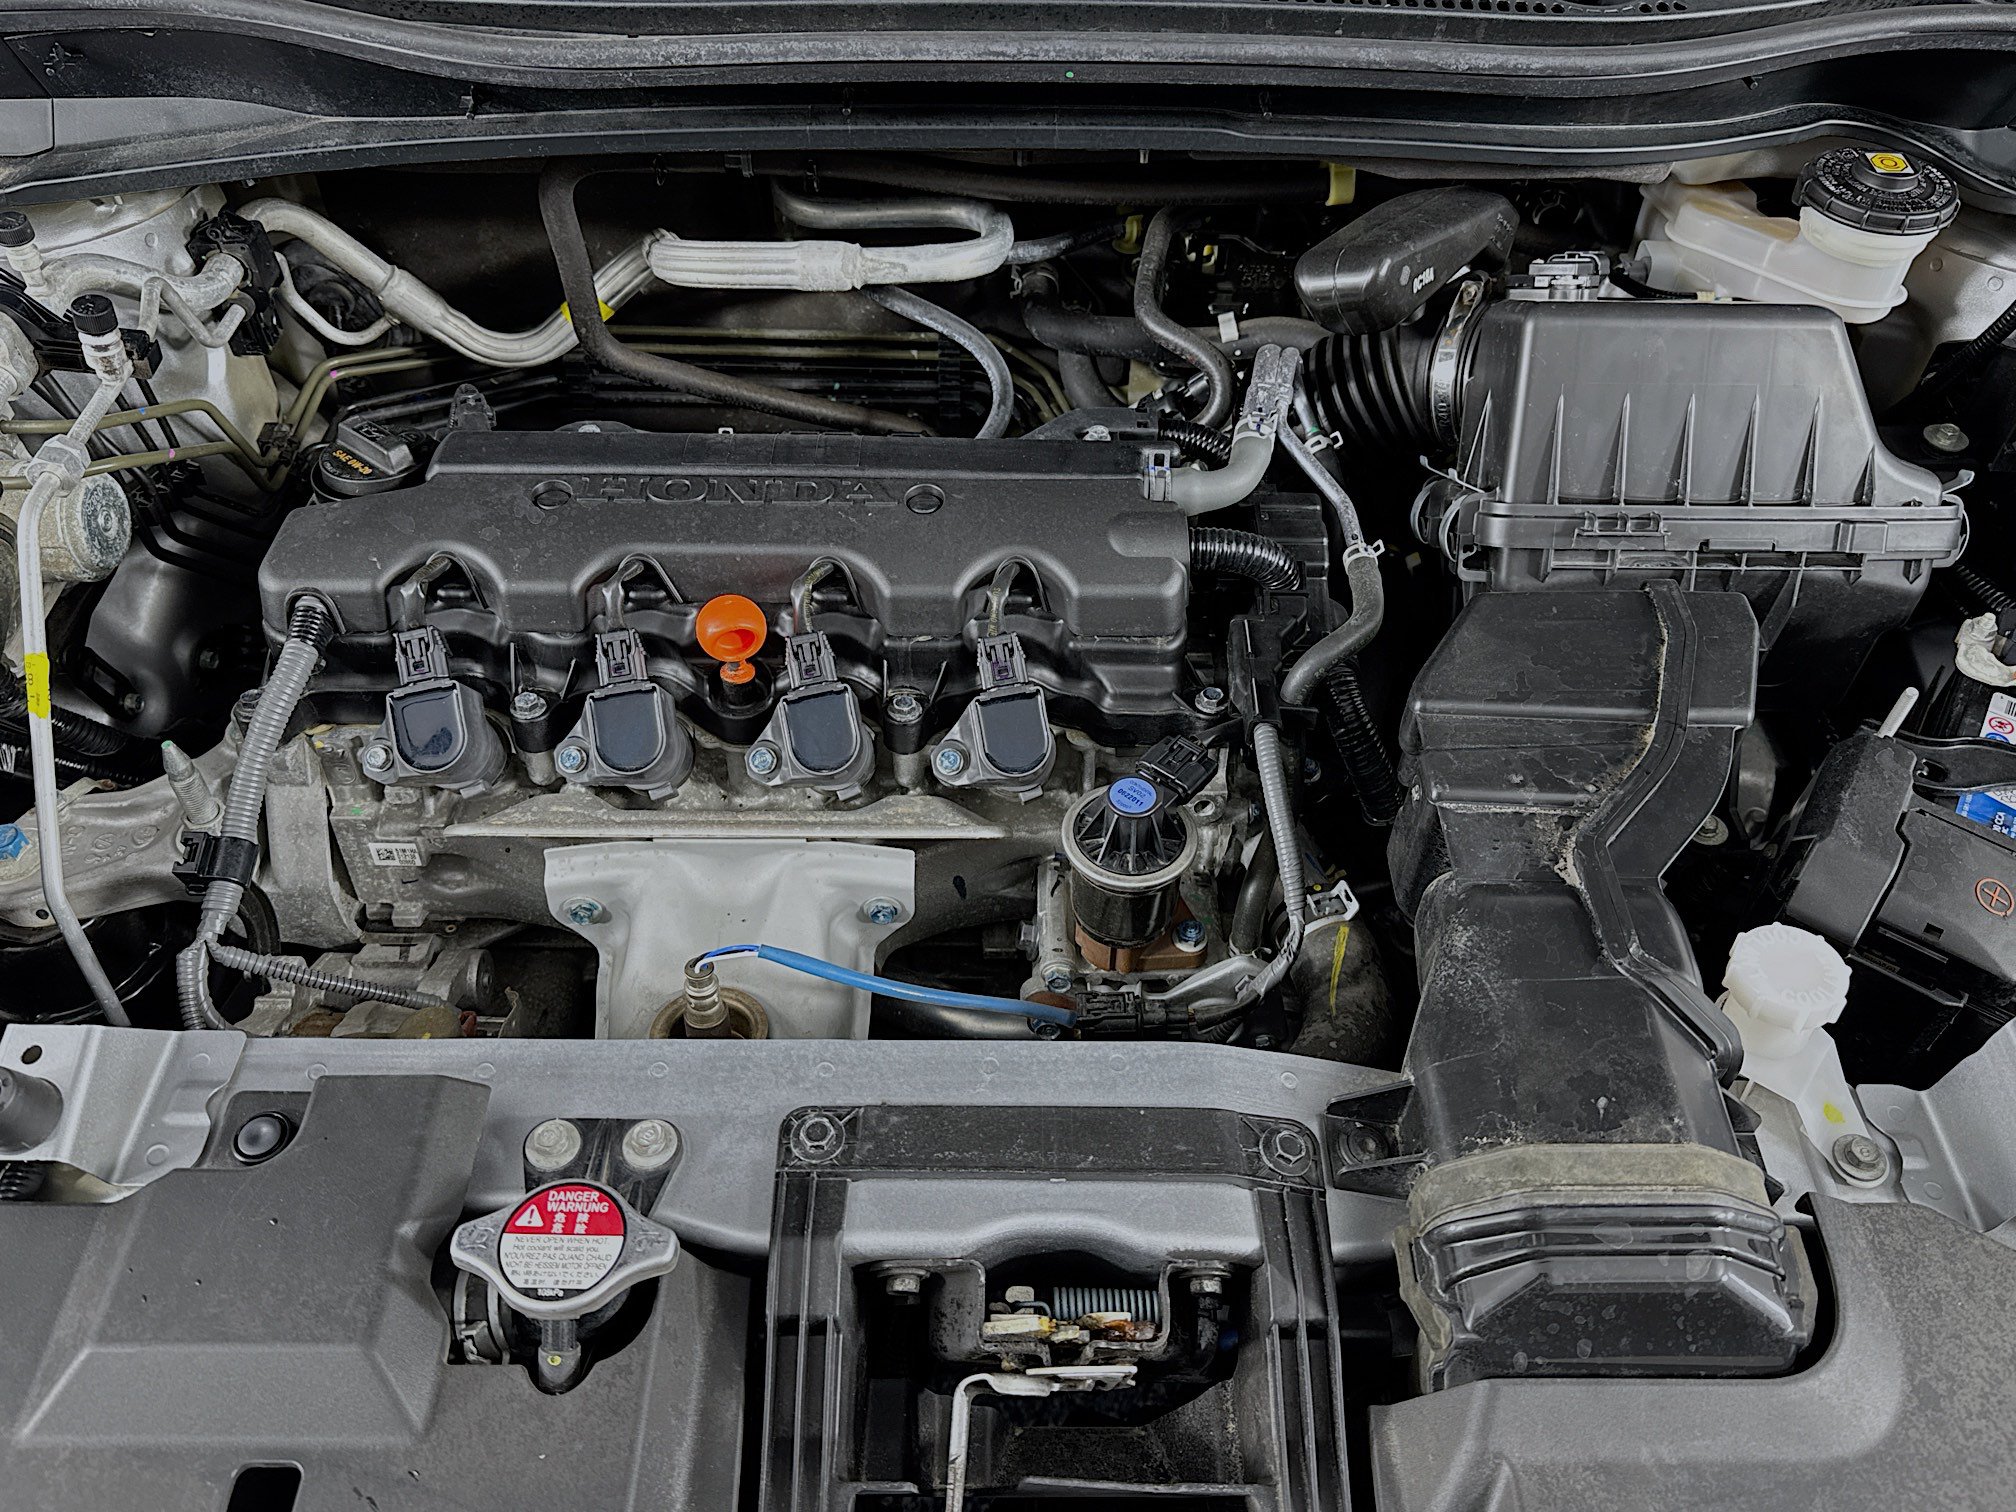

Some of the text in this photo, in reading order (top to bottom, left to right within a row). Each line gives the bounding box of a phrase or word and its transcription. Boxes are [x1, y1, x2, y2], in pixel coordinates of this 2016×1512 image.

[347, 458, 373, 475] 0W-20
[574, 475, 899, 505] HONDA
[1117, 788, 1144, 807] 0622011
[548, 1190, 600, 1202] DANGER
[546, 1201, 610, 1213] WARNUNG
[558, 1253, 584, 1261] QUAND
